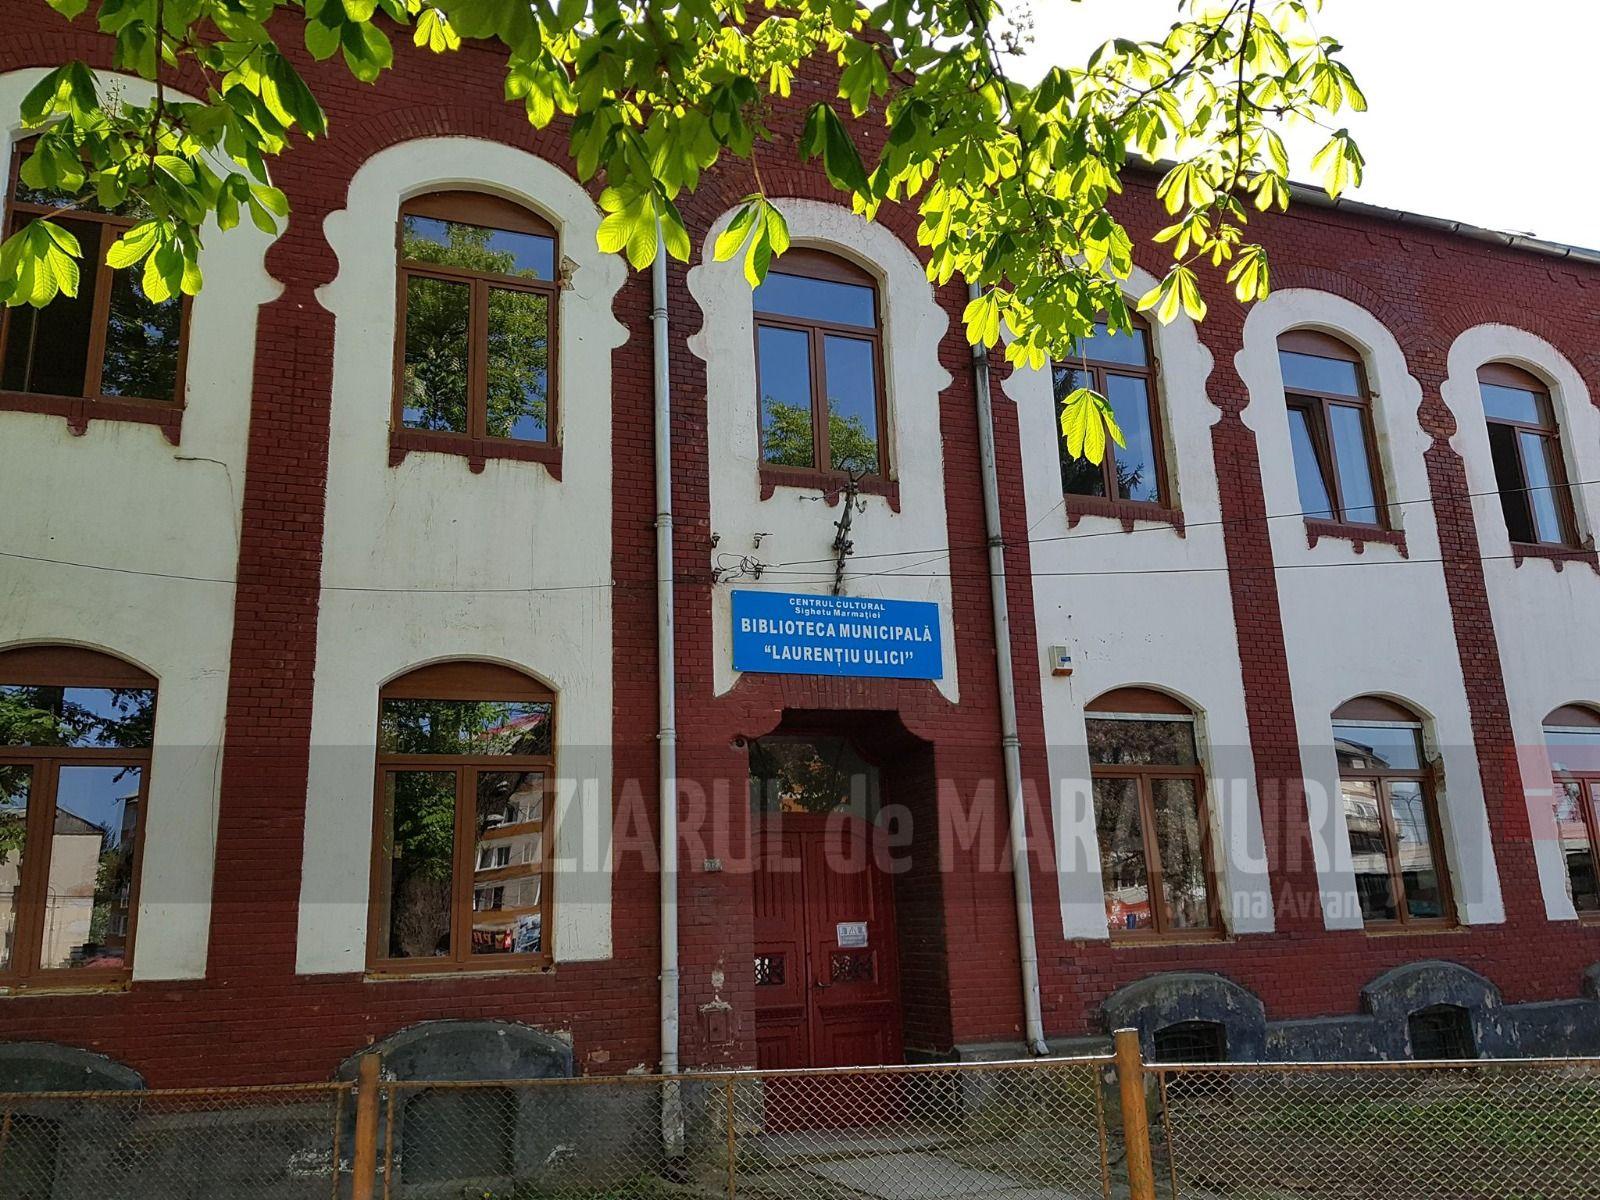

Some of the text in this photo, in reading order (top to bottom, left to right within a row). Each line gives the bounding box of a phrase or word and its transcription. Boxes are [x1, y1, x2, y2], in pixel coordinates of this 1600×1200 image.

[789, 597, 886, 611] CENTRUL CULTURAL
[794, 606, 832, 617] Sighetu
[740, 617, 933, 642] BIBLIOTECA MUNICIPALĂ
